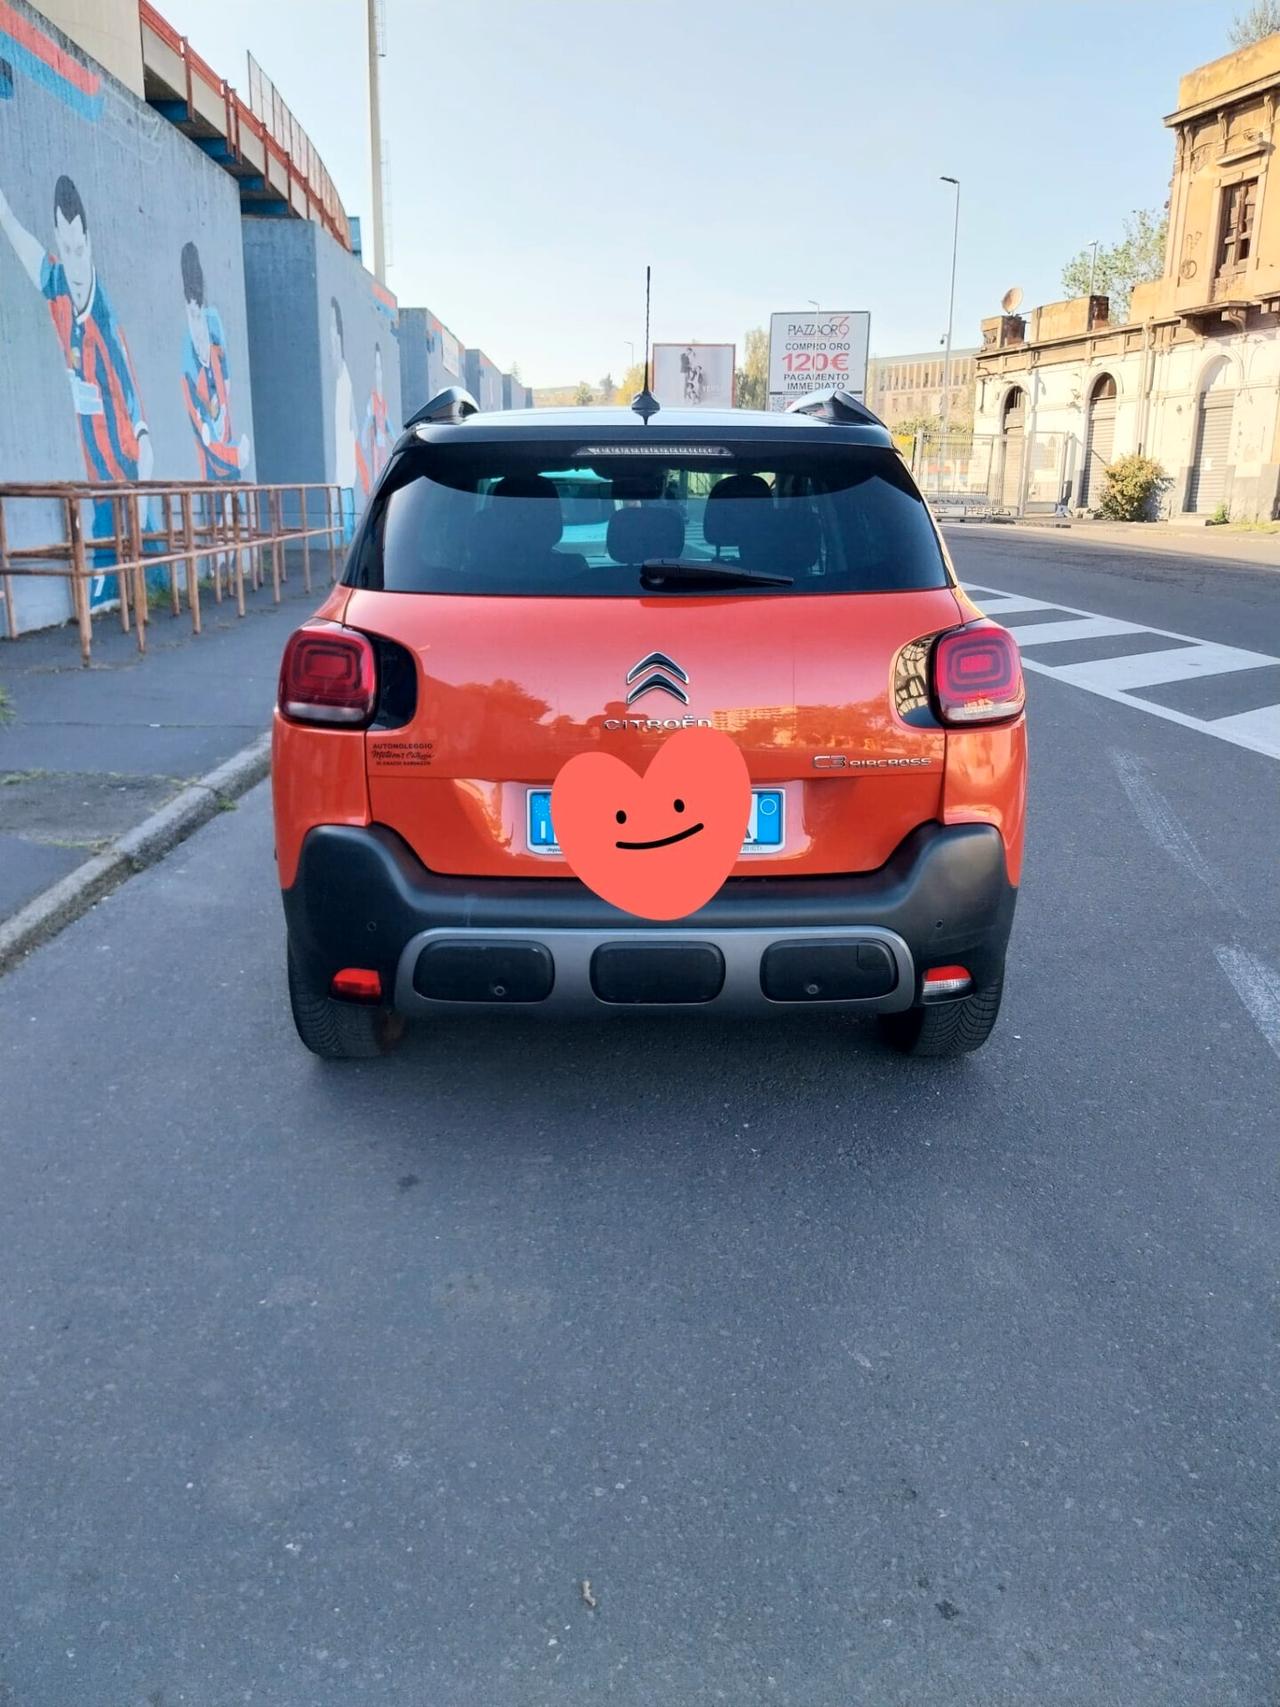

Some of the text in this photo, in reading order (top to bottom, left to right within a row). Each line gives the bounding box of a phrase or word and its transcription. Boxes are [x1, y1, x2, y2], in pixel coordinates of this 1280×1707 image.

[785, 342, 851, 351] COMPRO ORO
[782, 352, 850, 372] 120€
[783, 373, 850, 381] PAGAMENTO
[787, 382, 846, 390] IMMEDIATO
[813, 755, 933, 769] C3 AIRCROSS
